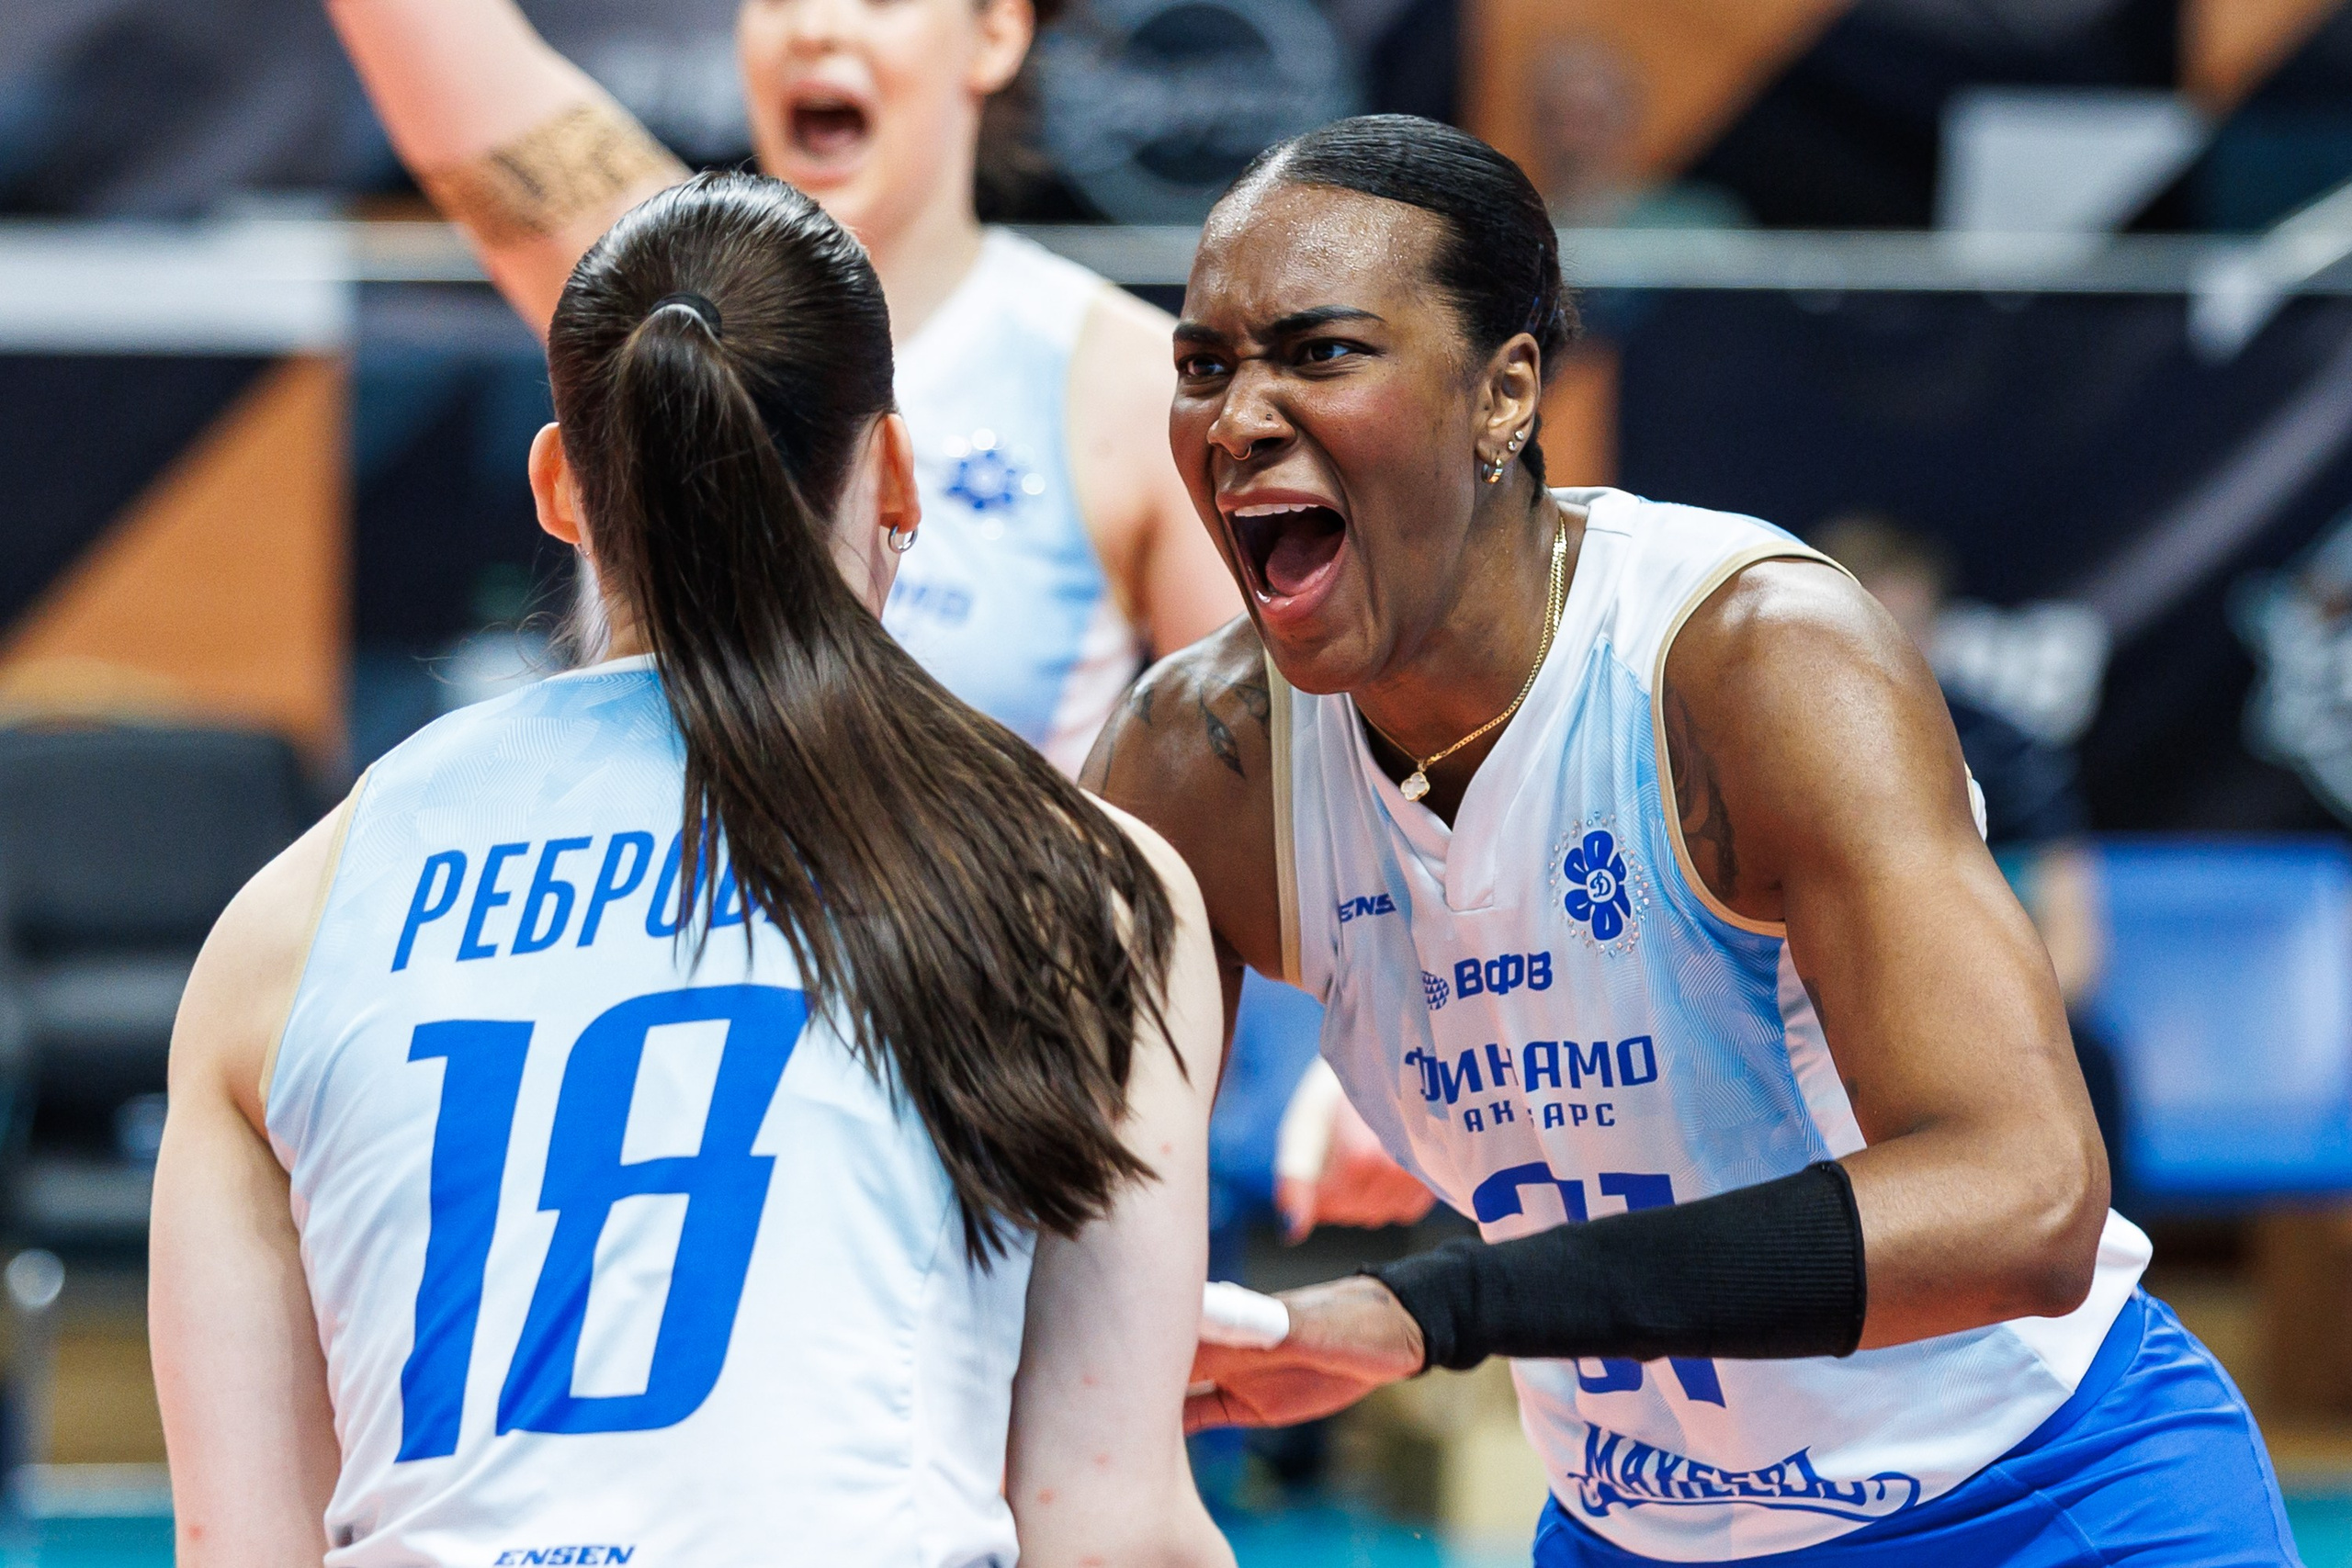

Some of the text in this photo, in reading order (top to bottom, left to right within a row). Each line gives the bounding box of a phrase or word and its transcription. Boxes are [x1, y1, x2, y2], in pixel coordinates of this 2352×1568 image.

[390, 817, 821, 973] РЕБРО
[1338, 893, 1397, 923] ENS
[1453, 950, 1554, 1000] ВФВ
[1527, 1102, 1616, 1130] АРС
[393, 983, 814, 1464] 18
